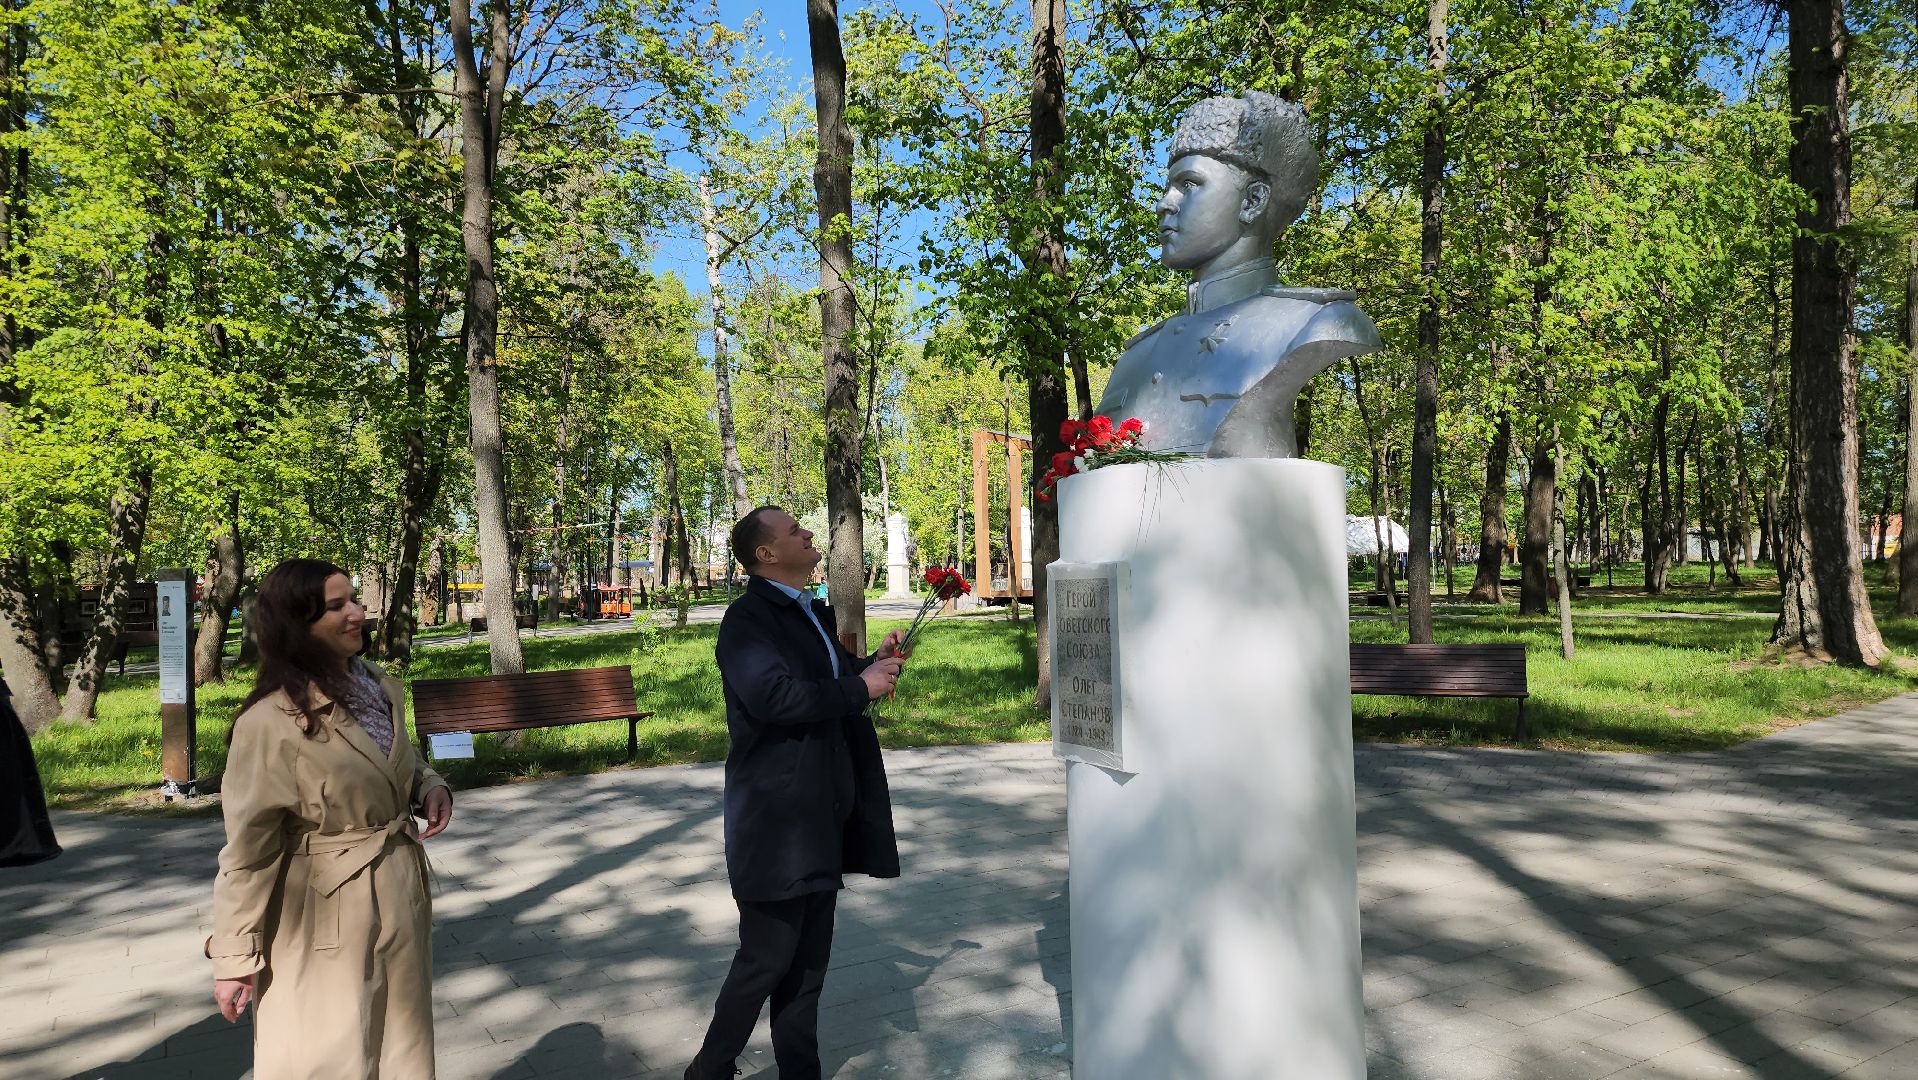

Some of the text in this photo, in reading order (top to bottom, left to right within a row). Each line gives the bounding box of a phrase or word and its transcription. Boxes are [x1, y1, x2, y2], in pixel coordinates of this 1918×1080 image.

[1066, 588, 1096, 608] ГЕРОЙ
[1058, 617, 1111, 633] ОВЕТСКОГО
[1066, 641, 1100, 659] СОЮЗА
[1072, 675, 1097, 695] ОЛЕГ
[1061, 700, 1111, 723] СТЕПАНОВ
